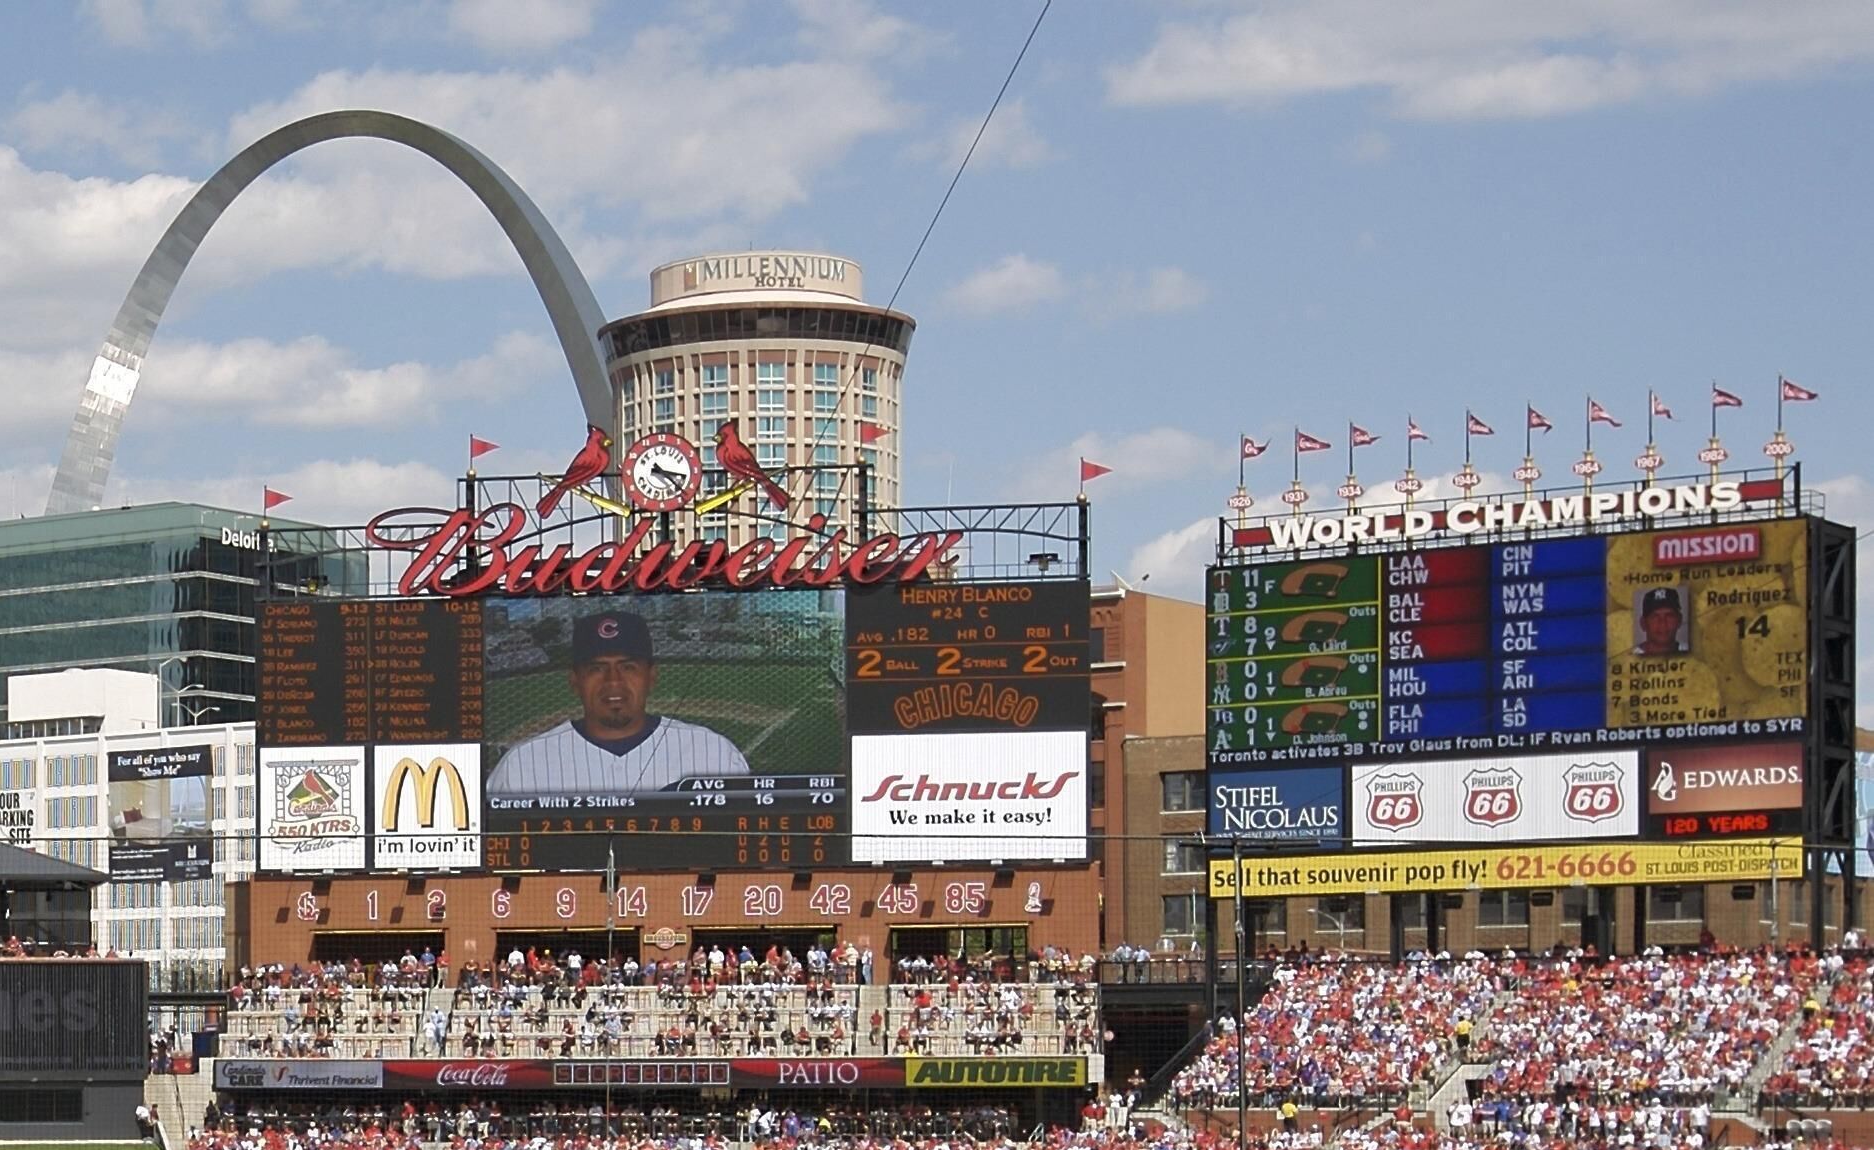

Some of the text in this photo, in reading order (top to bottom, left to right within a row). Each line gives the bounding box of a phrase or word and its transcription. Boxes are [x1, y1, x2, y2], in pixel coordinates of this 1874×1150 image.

[702, 256, 845, 282] MILLENNIUM
[755, 275, 804, 288] HOTEL
[1701, 450, 1725, 461] 1982
[1765, 444, 1792, 455] 2006
[1575, 462, 1599, 475] 1964
[1637, 456, 1661, 468] 1967
[1455, 474, 1478, 486] 1944
[1515, 468, 1539, 480] 1946
[1339, 485, 1361, 497] 1934
[1396, 480, 1419, 491] 1942
[1284, 491, 1306, 502] 1931
[1270, 482, 1742, 548] WORLD CHAMPIONS
[366, 501, 964, 596] Budweiser
[1503, 546, 1533, 561] CIN
[1389, 555, 1425, 571] LAA
[1503, 561, 1532, 576] PIT
[1389, 570, 1429, 586] CHW
[1629, 563, 1782, 584] Home Run Leaders
[902, 587, 1032, 604] HENRY BLANCO
[1503, 583, 1544, 598] NYM
[1707, 588, 1791, 607] Rodriguez
[1389, 593, 1424, 608] BAL
[1503, 598, 1544, 614] WAS
[1389, 608, 1421, 623] CLE
[1503, 622, 1538, 637] ATL
[1735, 615, 1770, 639] 14
[1389, 631, 1413, 645] KC
[1503, 637, 1537, 651] COL
[1389, 645, 1424, 660] SEA
[857, 650, 881, 677] 2
[936, 648, 961, 675] 2
[1023, 646, 1047, 673] 2
[1503, 660, 1526, 674] SF
[1630, 652, 1803, 675] Kinsler TEX
[1389, 668, 1419, 682] MIL
[1503, 675, 1533, 689] ARI
[1630, 669, 1801, 691] Rollins PHI
[1389, 682, 1426, 697] HOU
[1630, 686, 1799, 707] Bonds SF
[894, 682, 1039, 729] CHICAGO
[1389, 705, 1423, 718] FLA
[1503, 699, 1526, 712] LA
[1389, 720, 1418, 734] PHI
[1503, 713, 1526, 727] SD
[168, 752, 187, 762] who
[691, 777, 835, 790] AVG HR RBI
[1472, 776, 1514, 787] PHILLIPS
[1571, 770, 1616, 782] PHILLIPS
[1683, 766, 1798, 789] EDWARDS
[861, 771, 1080, 803] Schnucks
[1375, 781, 1415, 792] PHILLIPS
[491, 792, 834, 809] Career With 2 Strikes .178 16 70
[1215, 786, 1283, 809] STIFEL
[1472, 792, 1513, 815] 66
[1573, 787, 1614, 811] 66
[889, 807, 1052, 826] We make it easy!
[1375, 797, 1412, 820] 66
[1225, 806, 1338, 830] NICOLAUS
[1708, 815, 1769, 833] YEARS
[9, 828, 31, 845] SITE
[277, 820, 351, 838] 550 KTRS
[378, 838, 475, 853] i'm lovin' it
[1258, 866, 1301, 886] that
[1307, 862, 1399, 884] souvenir
[1405, 864, 1445, 885] pop
[1451, 859, 1487, 882] fly!
[1497, 852, 1637, 880] 621-6666
[1665, 861, 1700, 874] LOUIS
[367, 890, 378, 920] 1
[427, 889, 446, 919] 2
[491, 889, 511, 918] 6
[556, 888, 576, 917] 9
[617, 887, 648, 917] 14
[681, 886, 713, 915] 17
[744, 886, 783, 915] 20
[810, 885, 850, 914] 42
[878, 883, 918, 914] 45
[945, 883, 985, 913] 85
[436, 1063, 511, 1087] Coca-Cola
[556, 1063, 859, 1084] SCOREBOARD PATIO
[912, 1059, 1079, 1083] AUTOTIRE
[289, 1075, 378, 1085] Thrivent Financial
